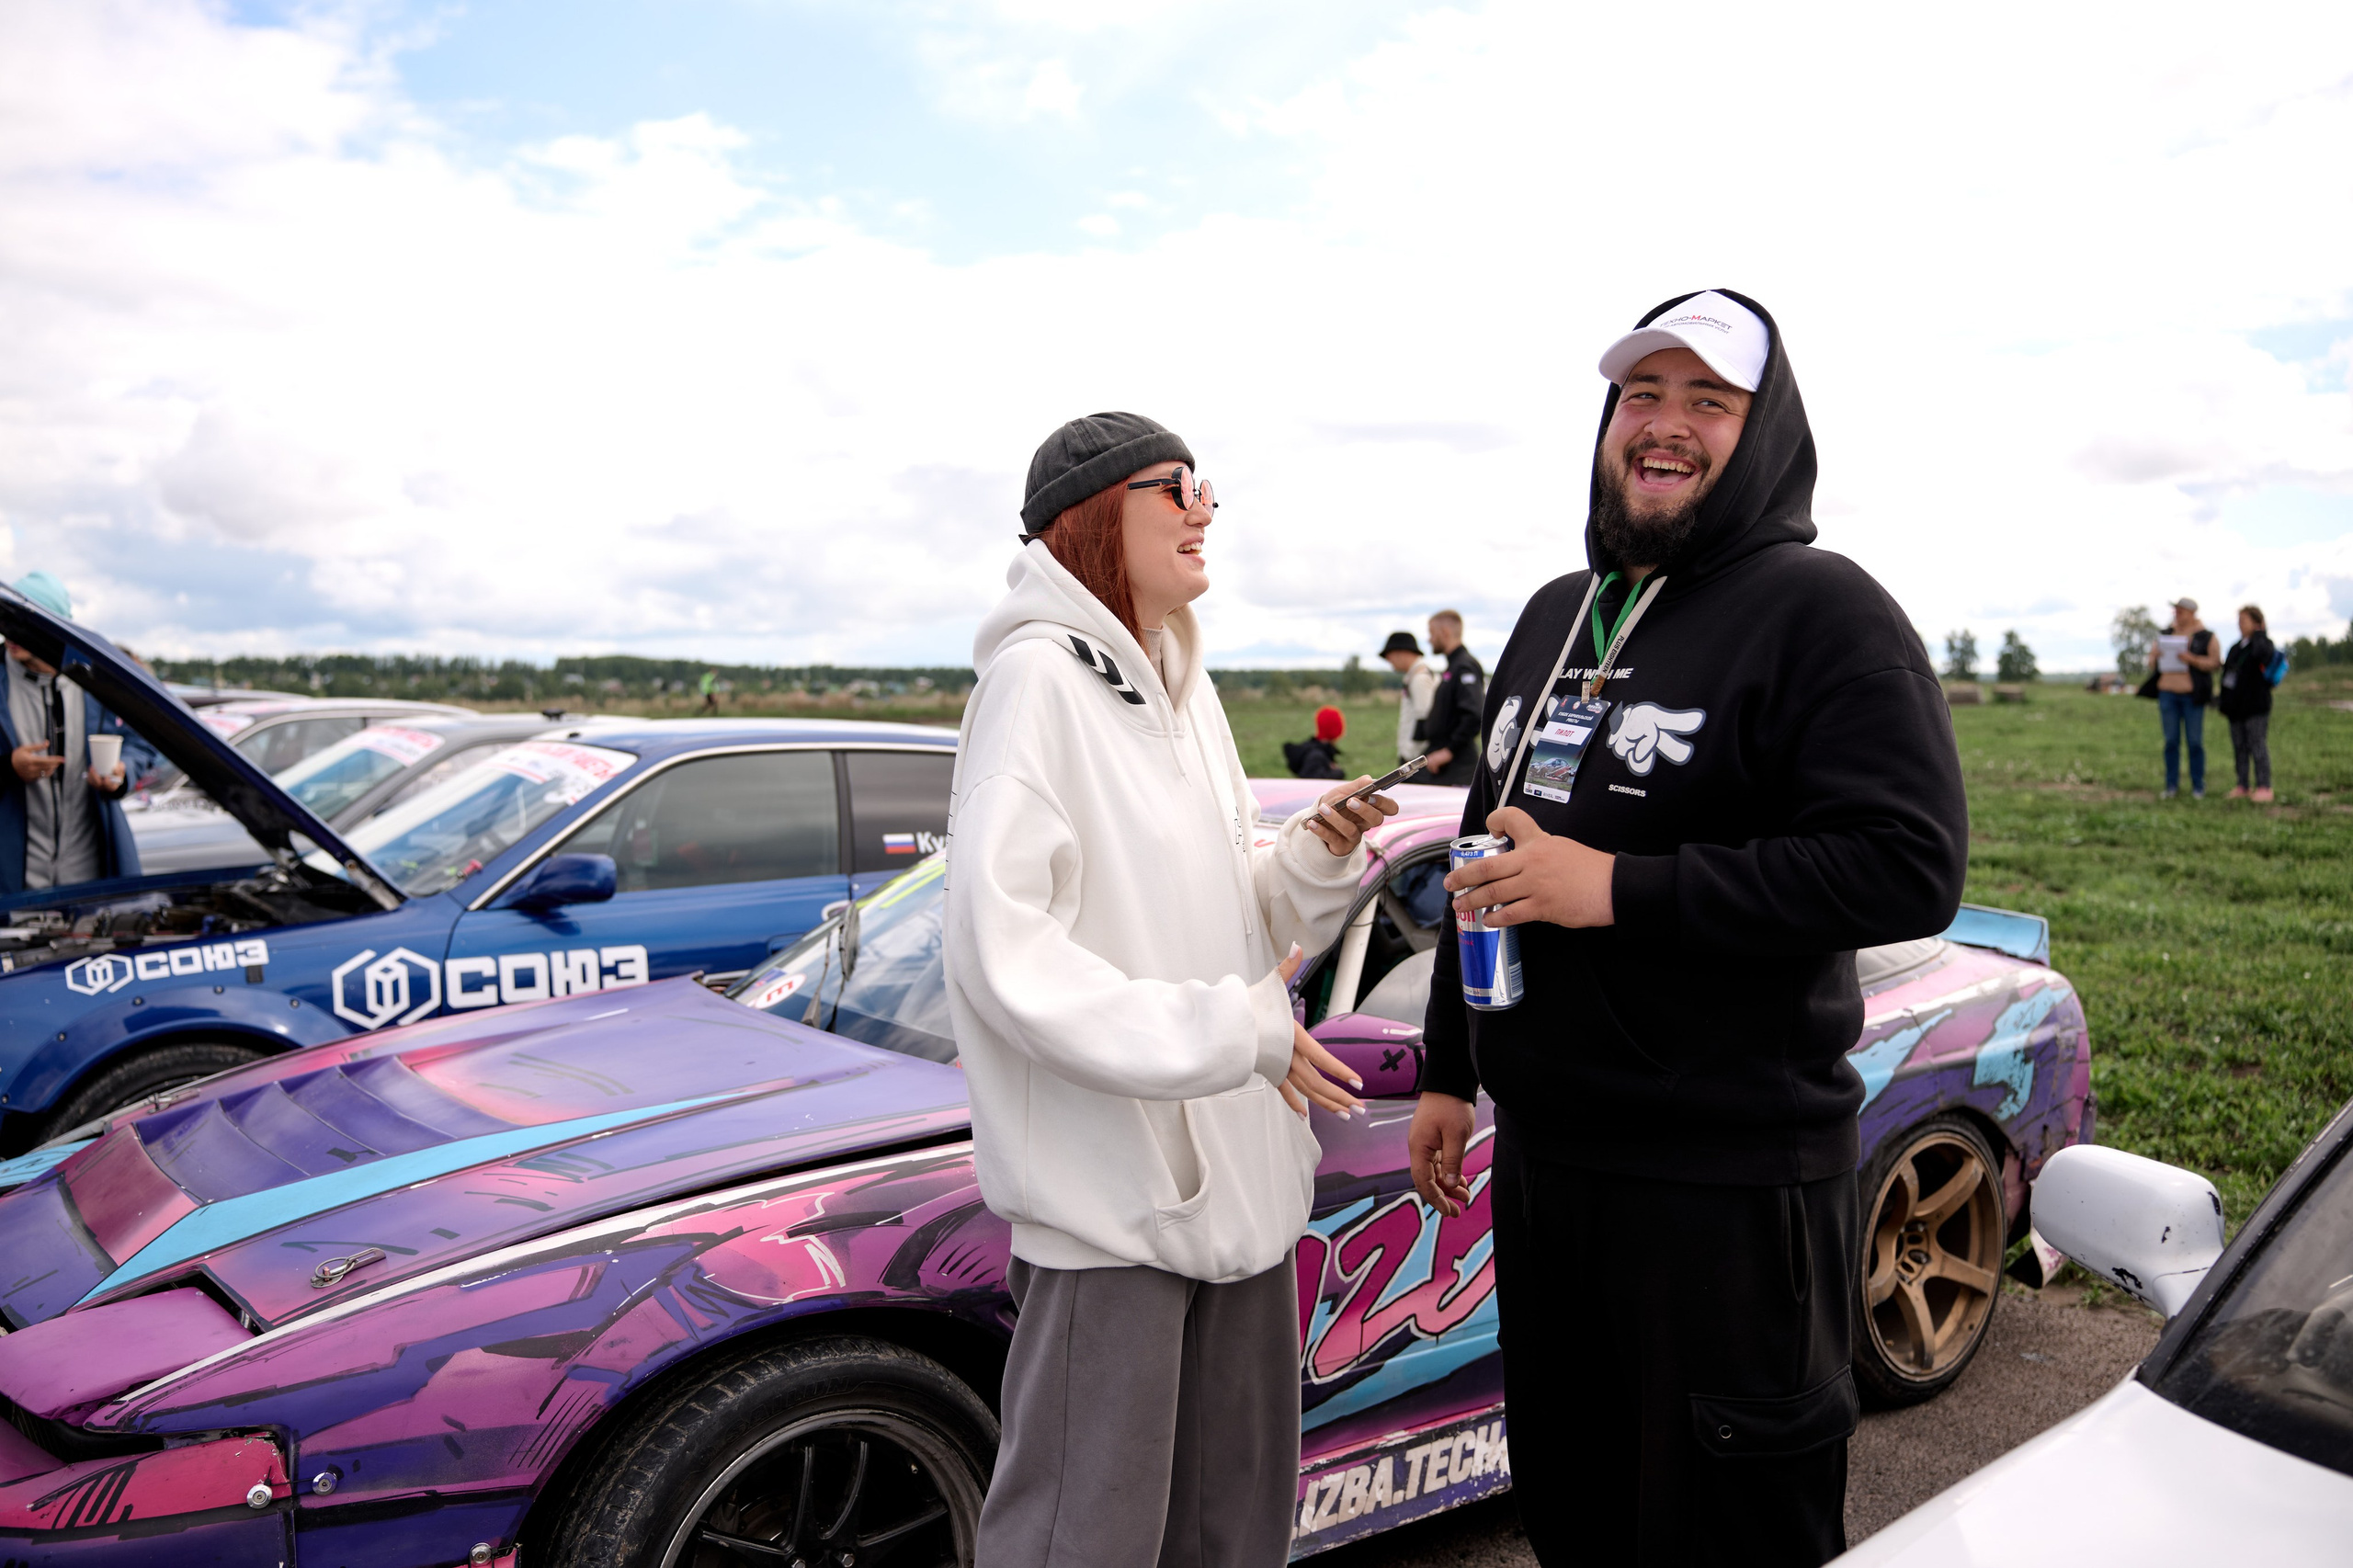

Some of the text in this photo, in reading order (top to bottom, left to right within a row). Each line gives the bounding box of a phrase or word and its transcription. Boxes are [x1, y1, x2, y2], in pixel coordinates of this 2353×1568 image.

[1602, 635, 1625, 674] PLUS EIGHTEEN
[1557, 668, 1583, 679] LAY
[1612, 667, 1634, 679] ME
[1554, 728, 1574, 737] ПИЛОТ
[1608, 783, 1646, 797] SCISSORS
[134, 938, 269, 981] СОЮЗ
[445, 945, 649, 1009] СОЮЗ
